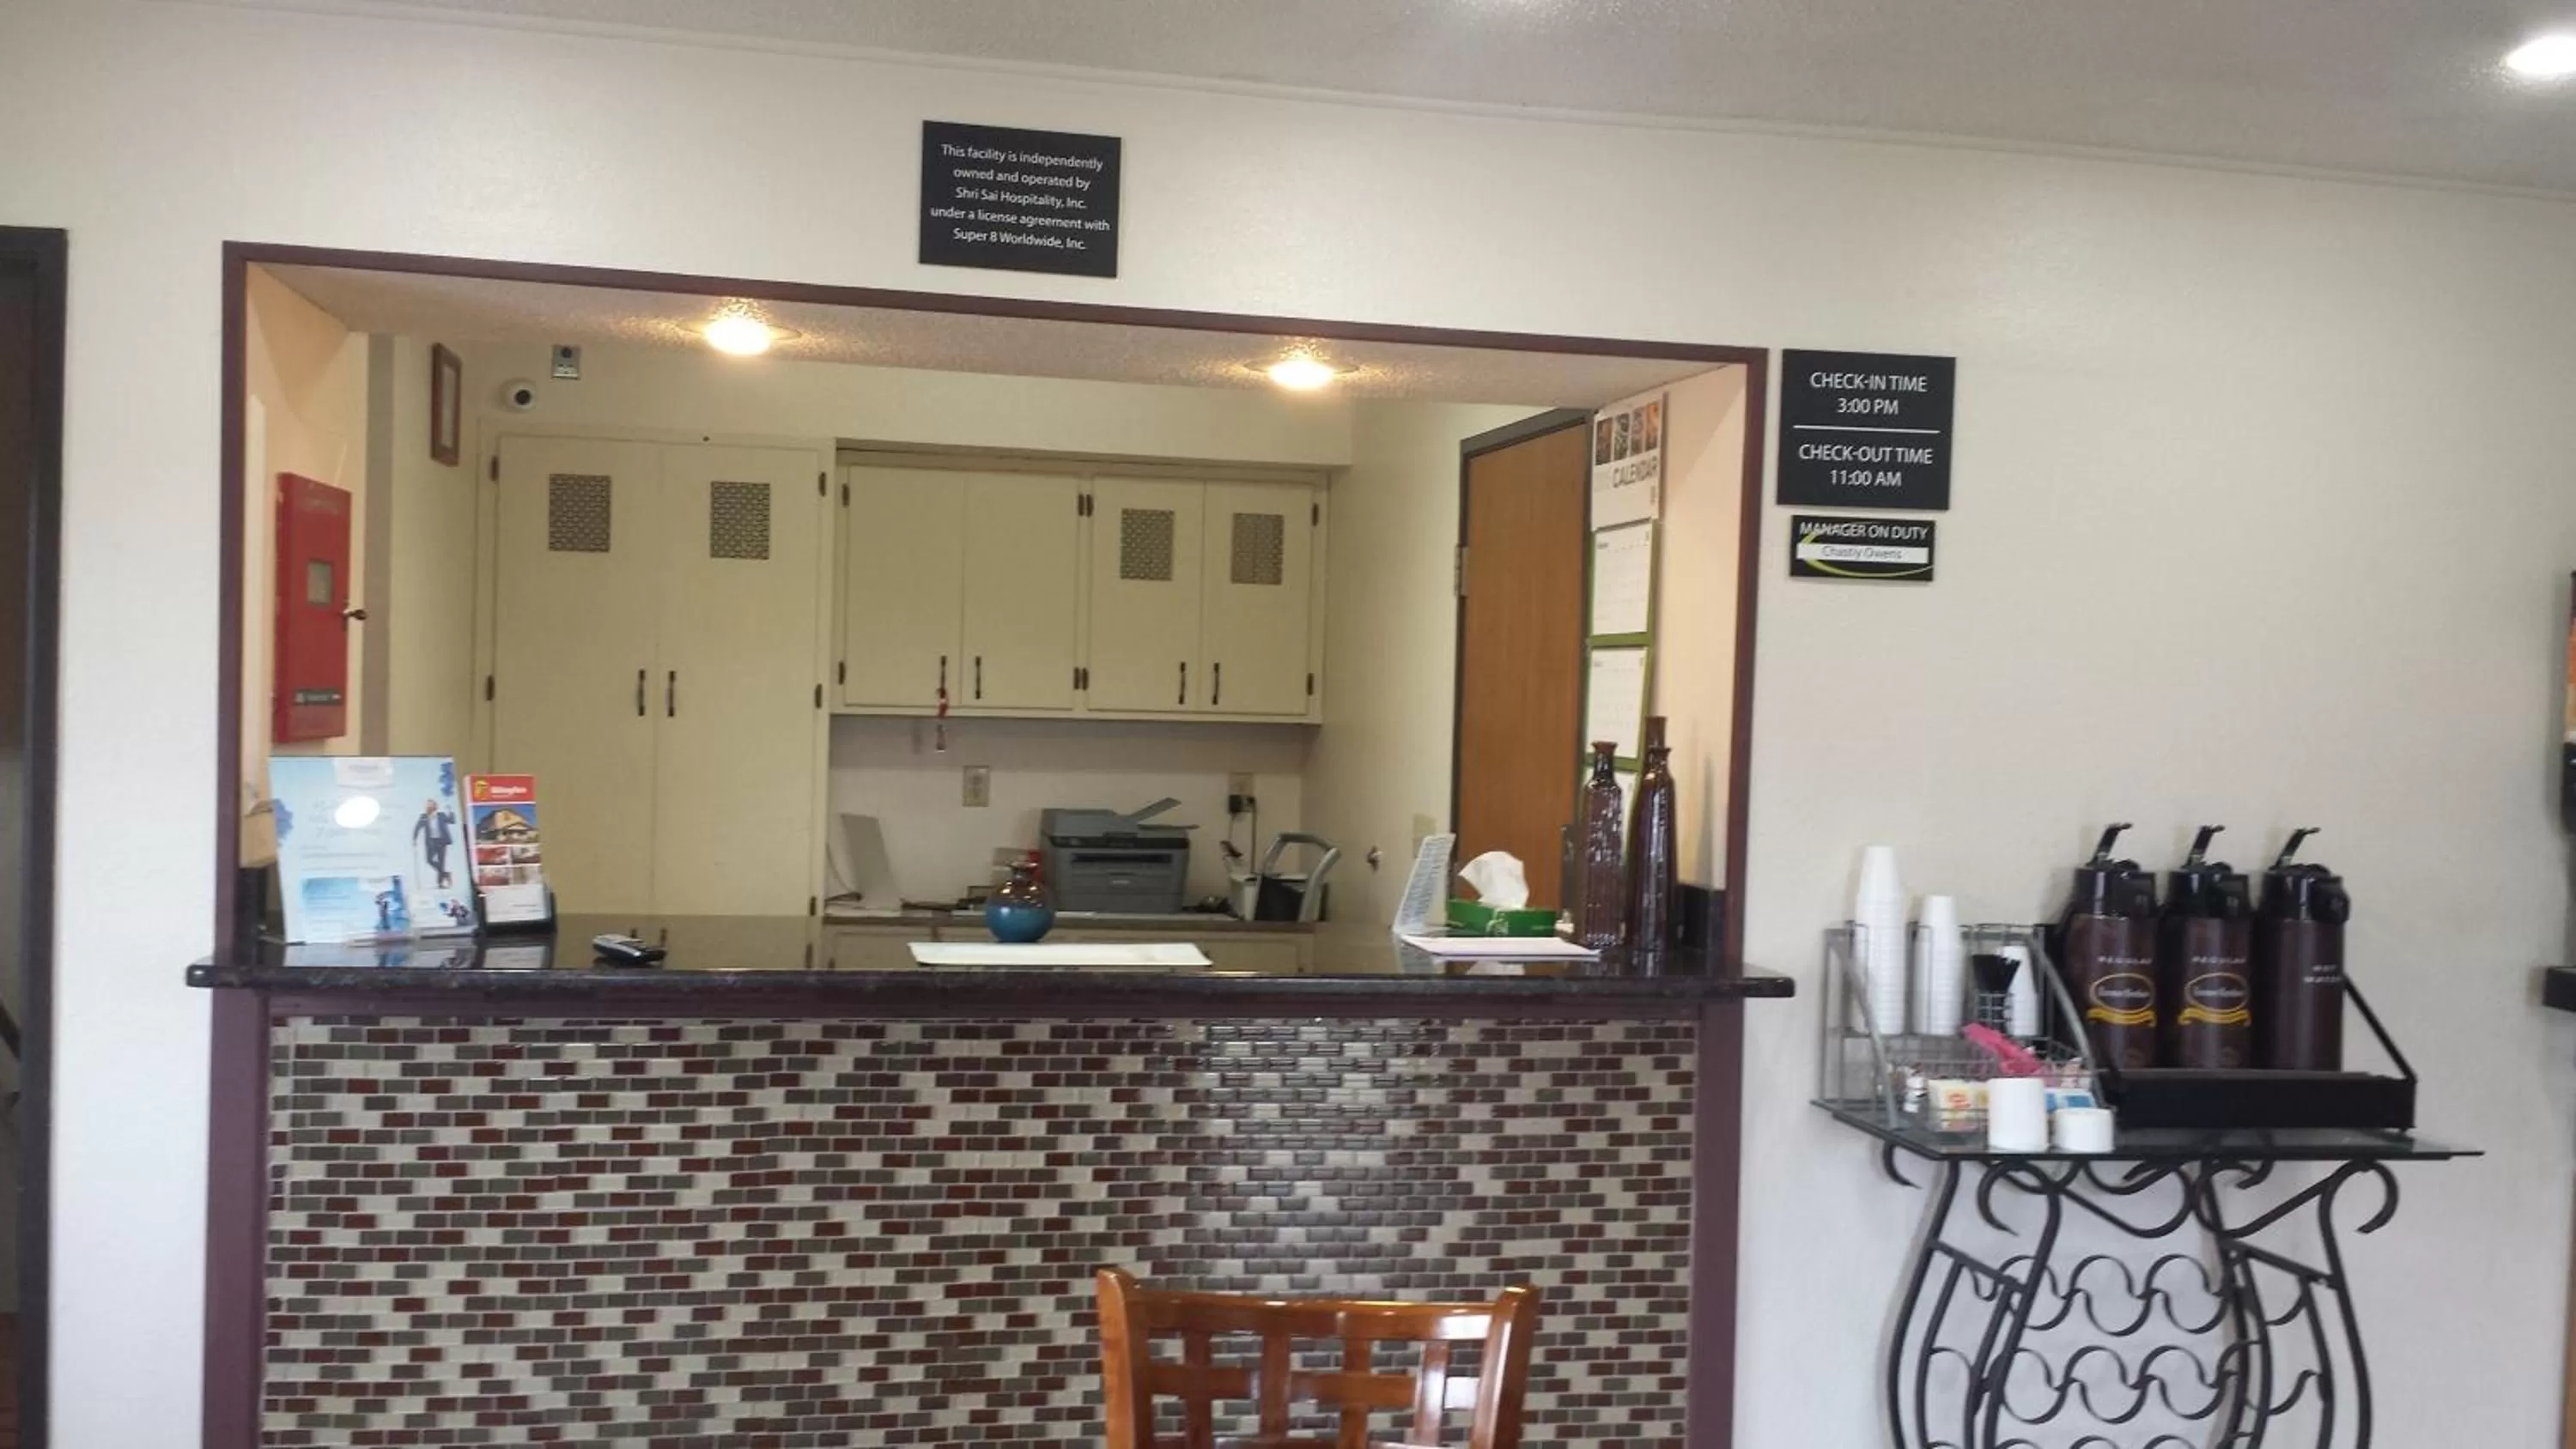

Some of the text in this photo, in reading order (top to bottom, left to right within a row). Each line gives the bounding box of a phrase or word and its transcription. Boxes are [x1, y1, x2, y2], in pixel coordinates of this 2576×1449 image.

[941, 143, 1103, 172] This facility is independently
[953, 169, 1091, 191] owned and operated by
[955, 187, 979, 199] Shri
[981, 189, 998, 201] Sai
[1066, 197, 1088, 209] Inc.
[931, 207, 965, 219] under
[977, 209, 1018, 224] license
[1019, 215, 1082, 229] agreement
[1084, 220, 1110, 232] with
[953, 228, 1088, 250] Super 8 Worldwide, Inc.
[1809, 372, 1927, 392] CHECK-IN TIME
[1838, 397, 1899, 415] 3:00 PM
[1799, 444, 1933, 464] CHECK-OUT TIME
[1831, 470, 1902, 487] 11:00 AM
[1800, 522, 1928, 540] MANAGER ON DUTY
